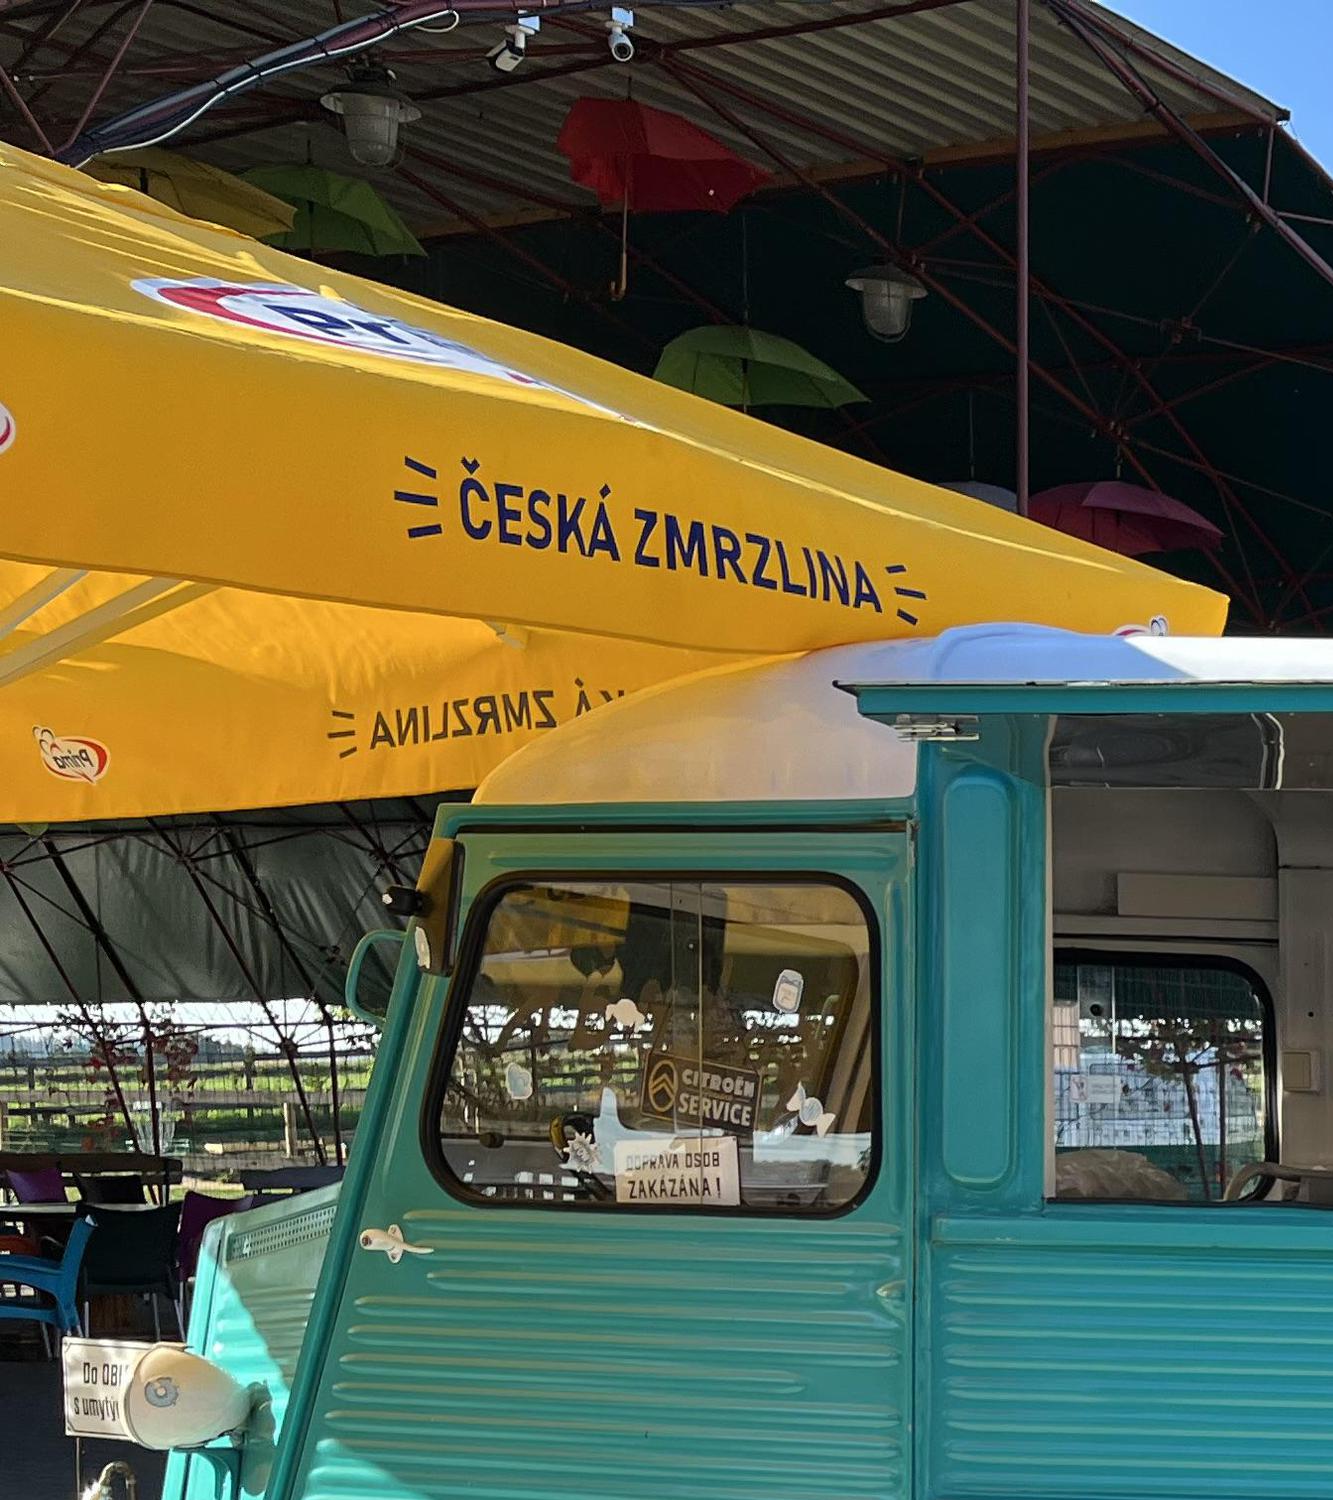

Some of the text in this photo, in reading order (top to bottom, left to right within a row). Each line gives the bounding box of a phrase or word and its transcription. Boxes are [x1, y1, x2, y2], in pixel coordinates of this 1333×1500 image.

[459, 456, 883, 613] ČESKÁ ZMRZLINA
[681, 1068, 755, 1098] CITROËN
[678, 1092, 753, 1127] SERVICE
[626, 1151, 720, 1171] DOPRAVA OSOB
[83, 1361, 98, 1385] Do
